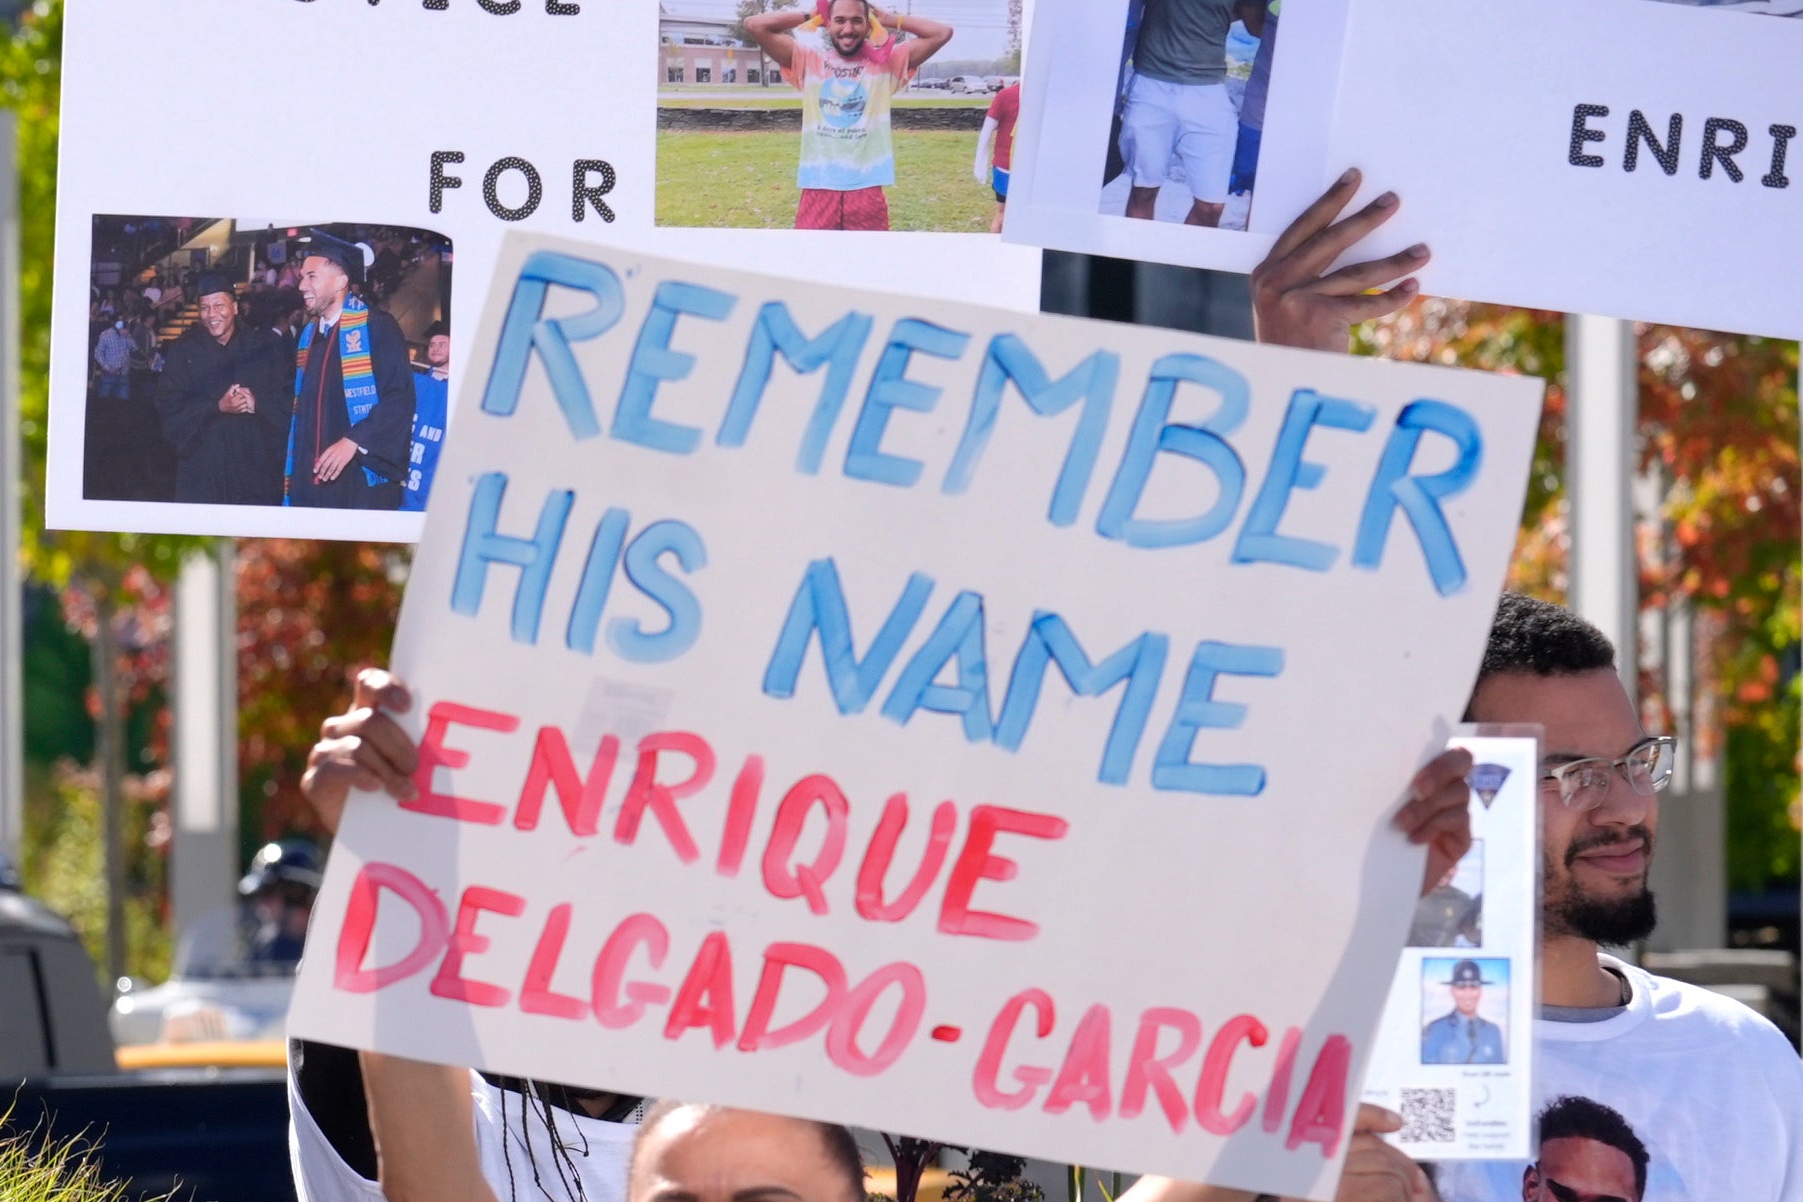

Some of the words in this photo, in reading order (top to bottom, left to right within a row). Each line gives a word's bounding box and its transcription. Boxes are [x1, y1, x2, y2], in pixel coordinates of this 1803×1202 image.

[429, 150, 616, 223] FOR
[1568, 103, 1796, 189] ENRI
[419, 424, 443, 443] AND
[479, 248, 1484, 597] REMEMBER
[448, 472, 708, 666] HIS
[760, 555, 1286, 797] NAME
[399, 700, 1071, 942] ENRIQUE
[333, 860, 1352, 1158] DELGADO-GARCIA
